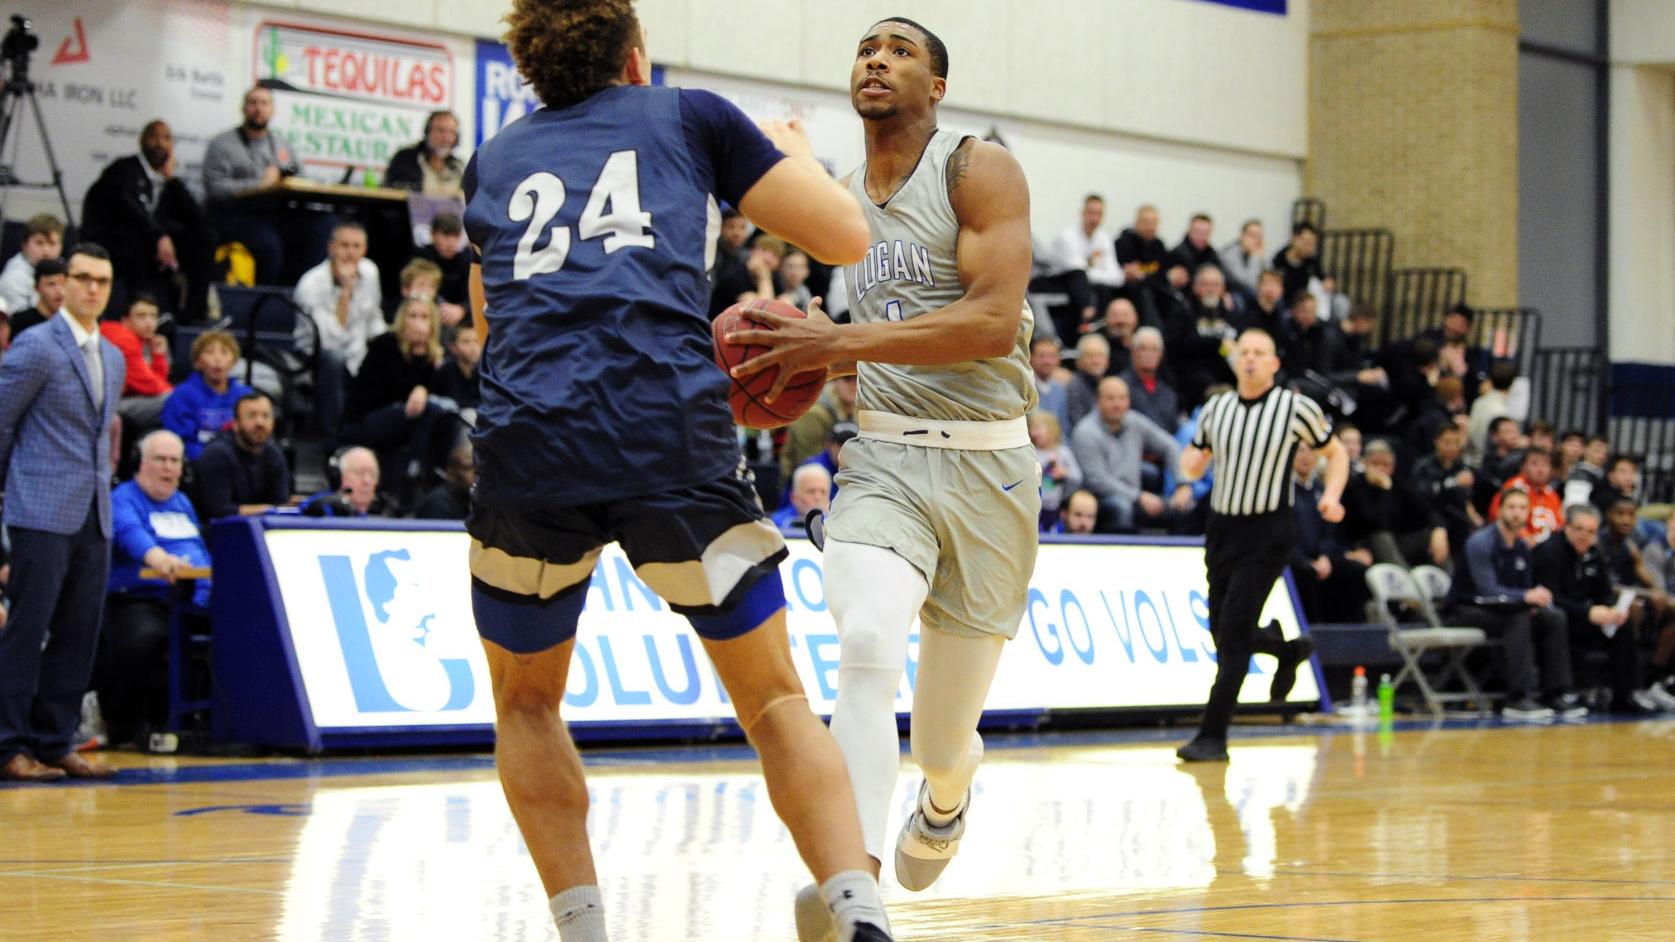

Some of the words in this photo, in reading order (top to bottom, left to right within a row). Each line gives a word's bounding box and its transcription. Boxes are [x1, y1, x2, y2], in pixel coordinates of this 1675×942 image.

[64, 83, 103, 104] IRON
[110, 87, 138, 110] LLC
[303, 47, 446, 103] TEQUILAS
[275, 128, 399, 163] ESTAUR
[291, 103, 412, 137] MEXICAN
[508, 149, 656, 281] 24
[854, 240, 935, 303] LOGAN
[1027, 587, 1095, 666] GO
[1099, 588, 1219, 664] VOLS
